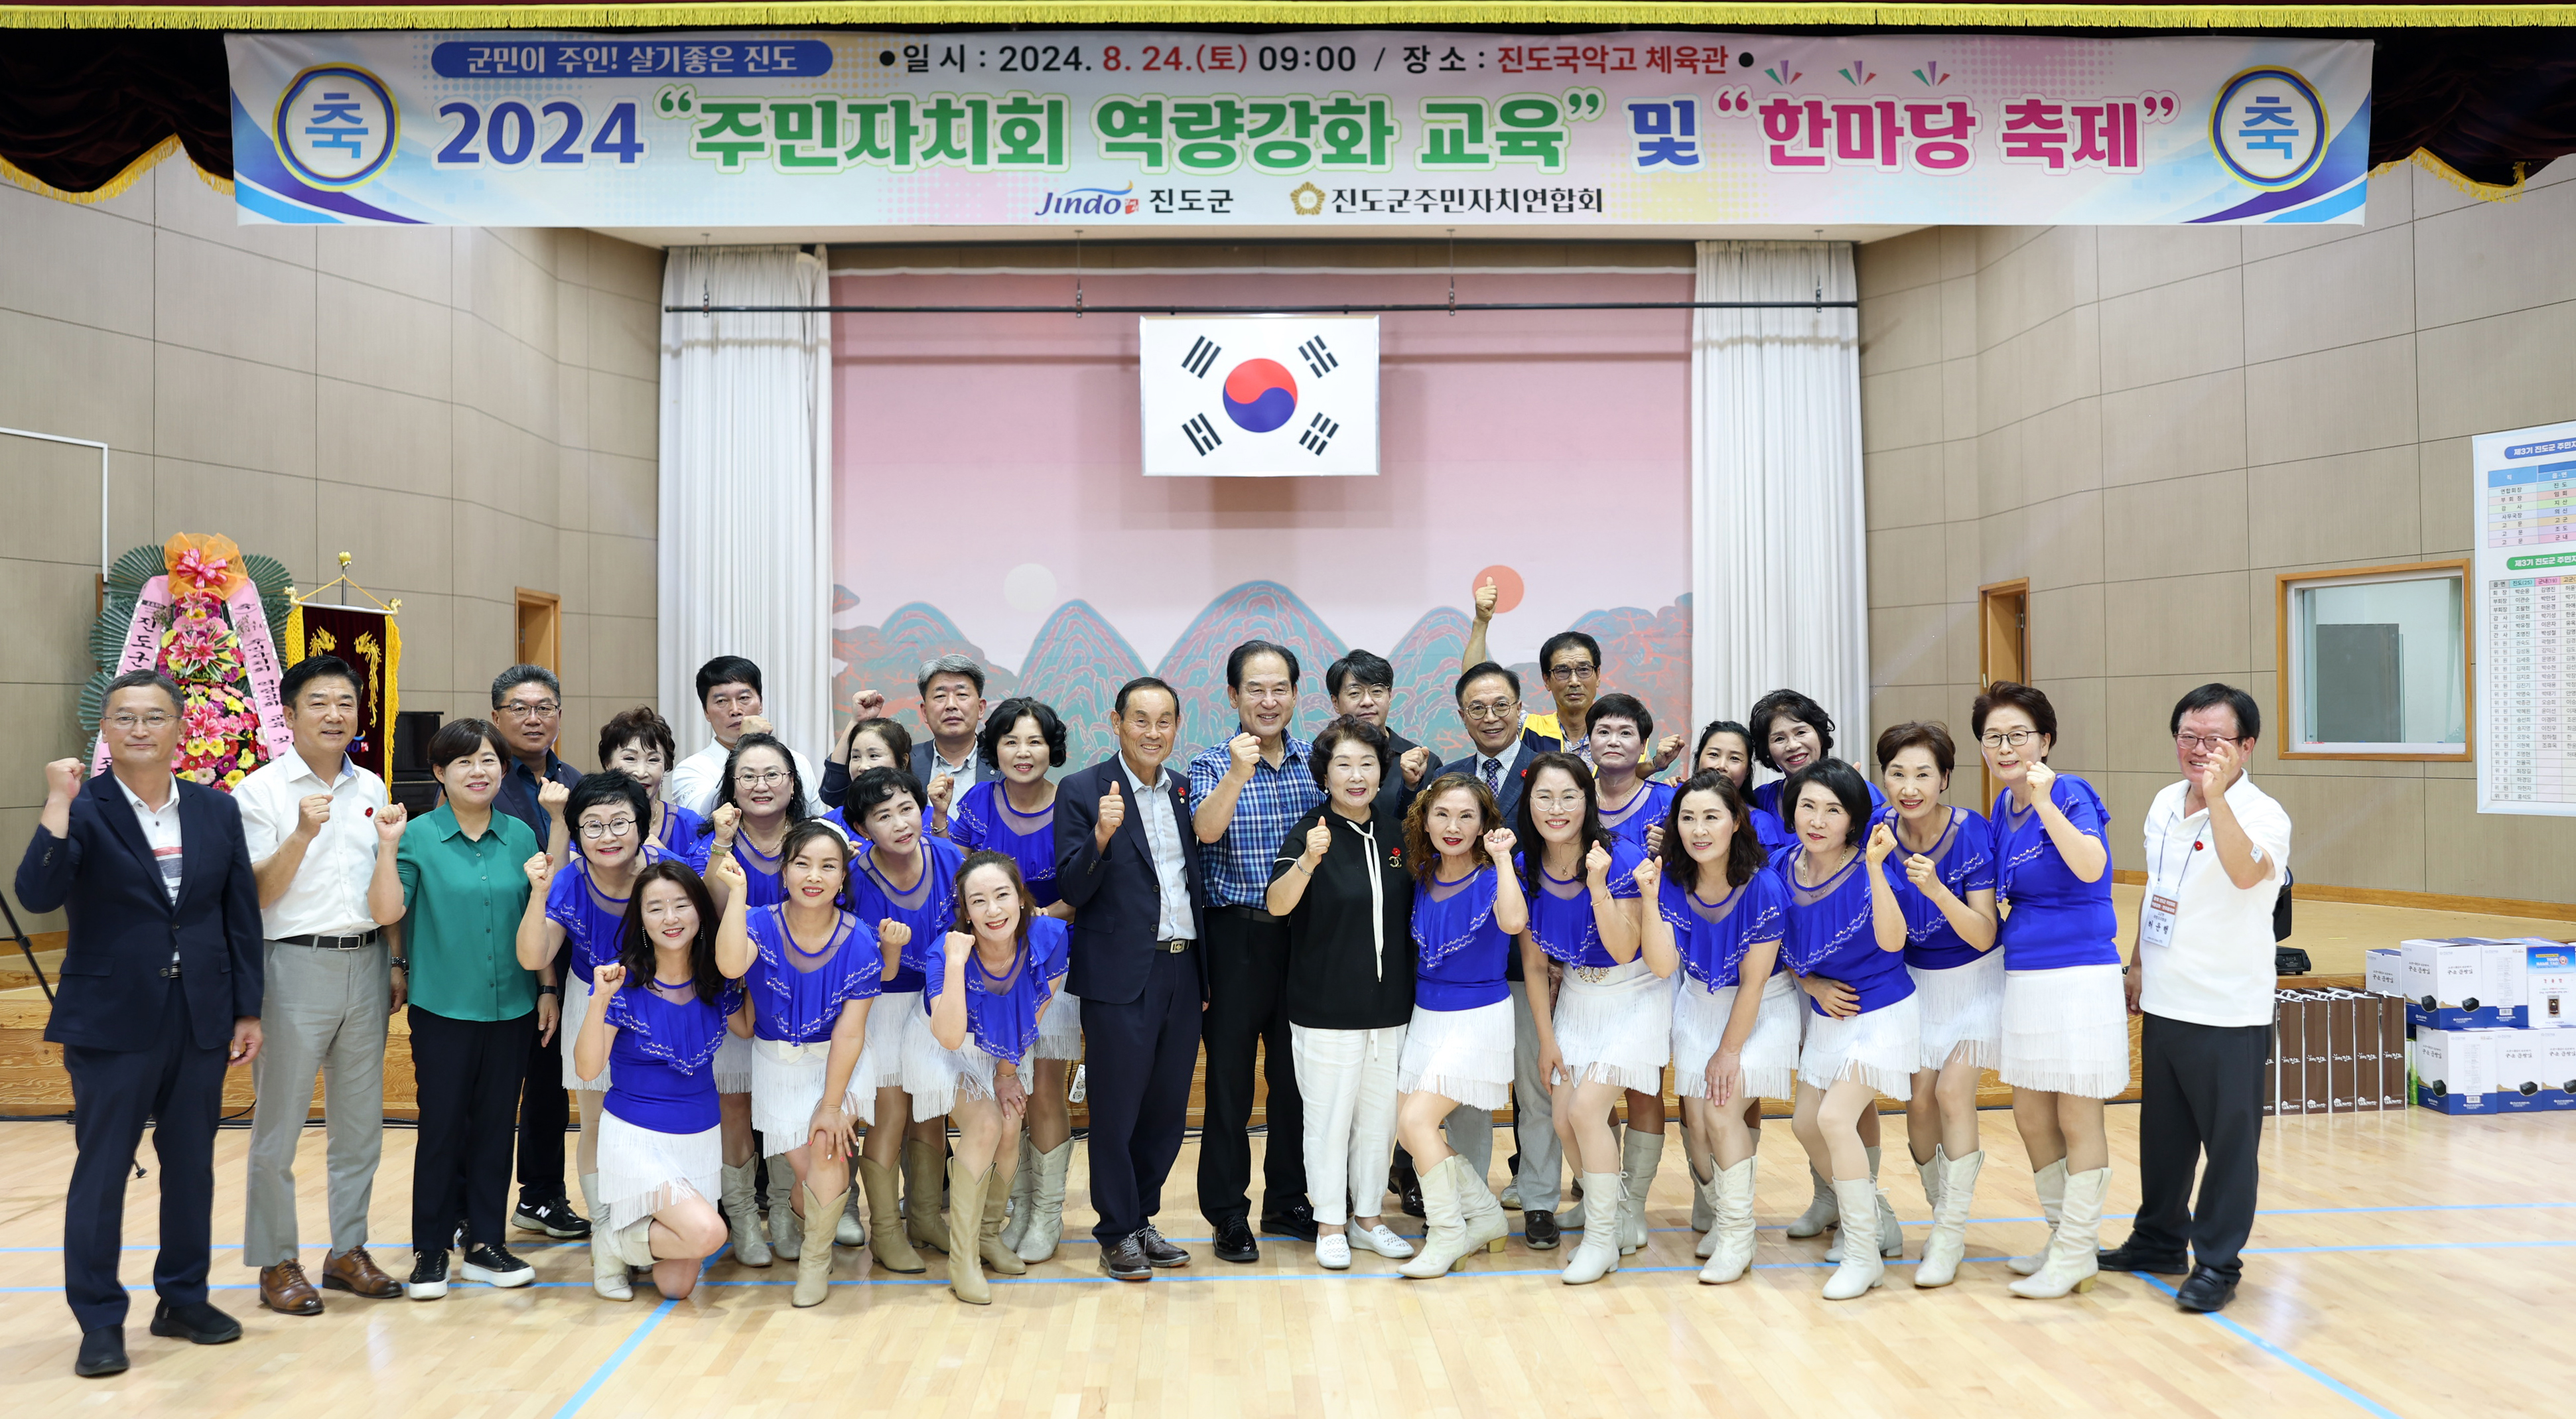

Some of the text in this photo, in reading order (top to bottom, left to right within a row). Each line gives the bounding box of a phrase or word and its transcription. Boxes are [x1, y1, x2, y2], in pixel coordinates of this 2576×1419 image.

[466, 44, 797, 75] 군민이 주인! 살기좋은 진도
[999, 45, 1092, 73] 2024.
[1103, 45, 1131, 73] 8.
[1142, 44, 1247, 76] 24.(토)
[1258, 45, 1357, 73] 09:00
[1497, 45, 1636, 76] 진도국악고
[1645, 46, 1729, 76] 체육관
[305, 92, 370, 160] 축
[437, 85, 2175, 169] 2024 “주민자치회 역량강화 교육” 및 “한마당 축제”
[2238, 96, 2299, 159] 축
[1034, 192, 1121, 216] Jindo
[1149, 188, 1233, 214] 진도군
[1331, 188, 1603, 213] 진도군주민자치연합회
[2514, 446, 2533, 456] 제3기
[2535, 444, 2555, 454] 진도군
[2514, 558, 2534, 567] 제3기
[2536, 557, 2556, 566] 진도군
